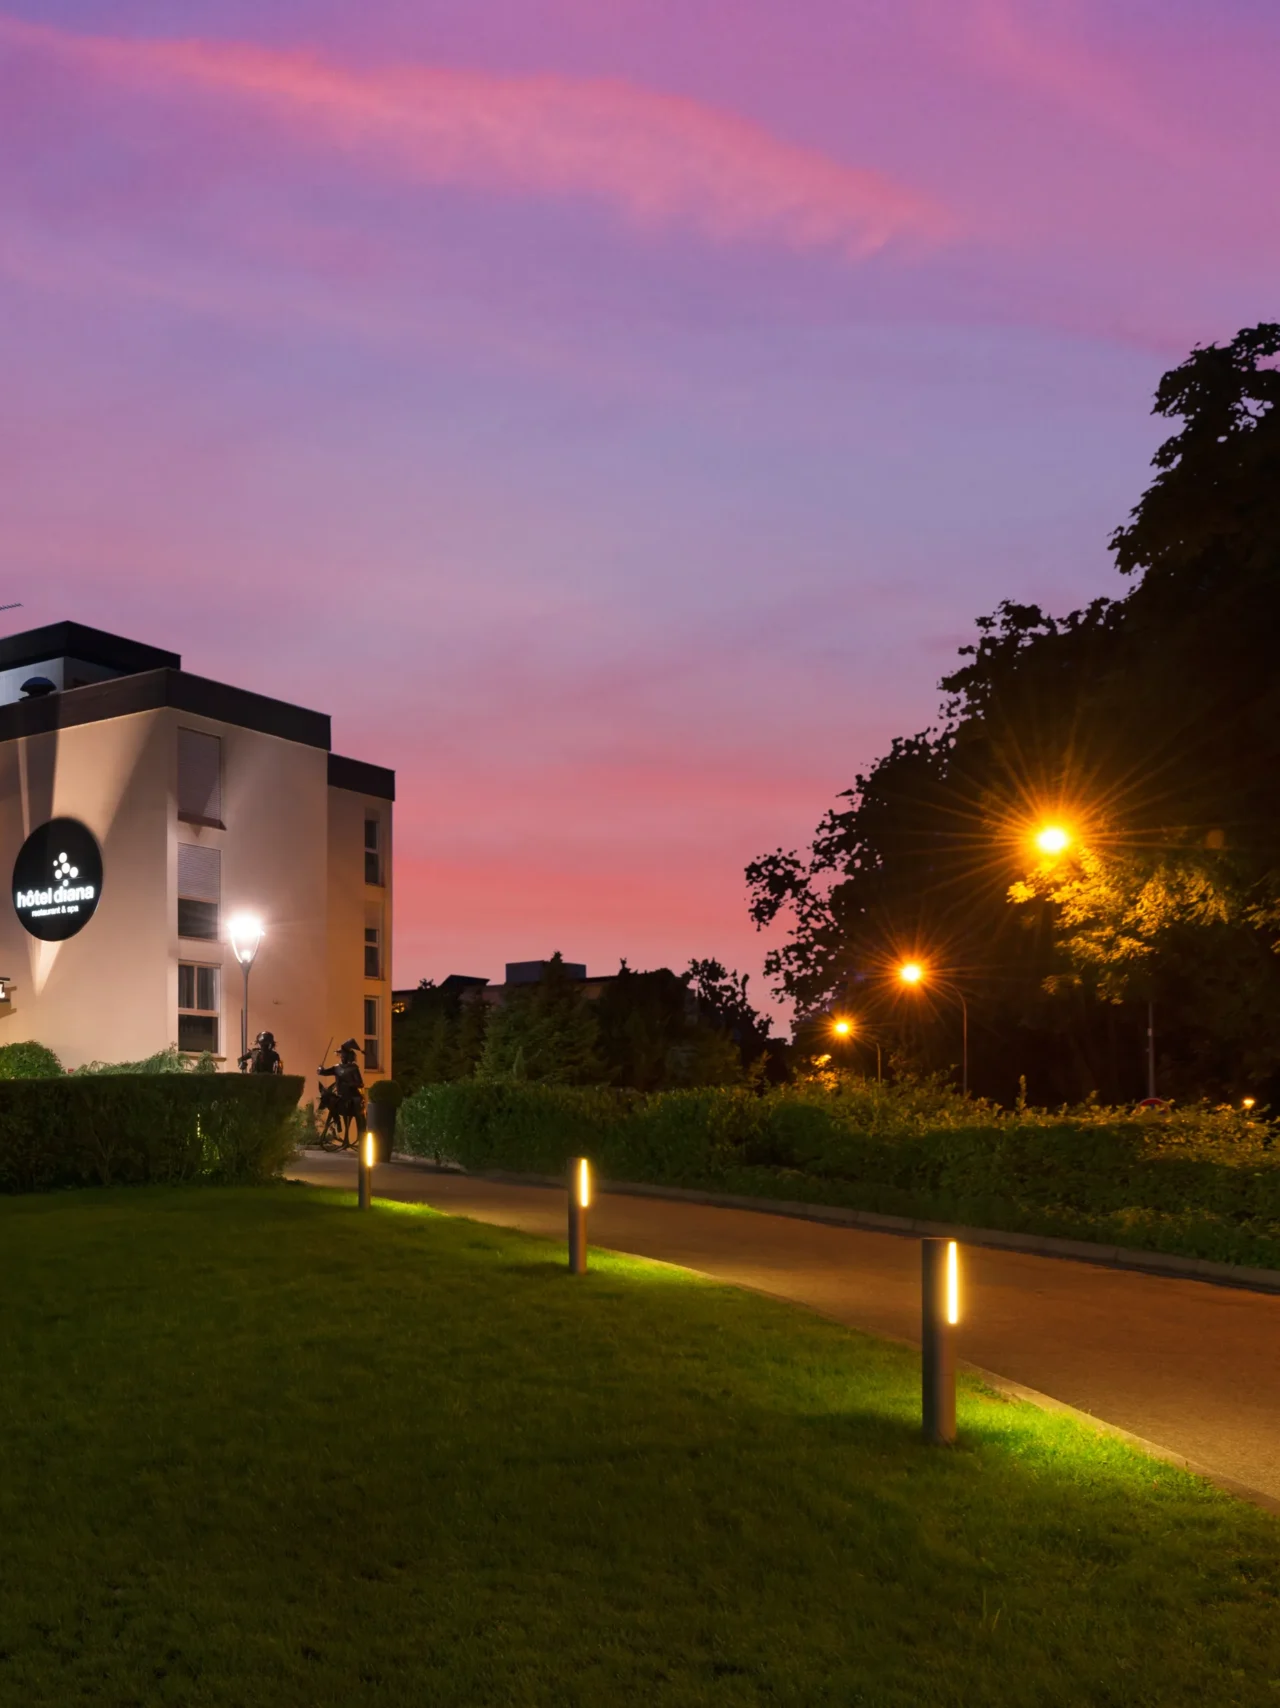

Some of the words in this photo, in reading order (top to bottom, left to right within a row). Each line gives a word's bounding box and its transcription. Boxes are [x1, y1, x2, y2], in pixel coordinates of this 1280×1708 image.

[17, 887, 52, 908] hôtel
[54, 879, 94, 904] diana
[32, 906, 60, 917] restaurant
[61, 905, 66, 914] &
[67, 905, 79, 914] spa
